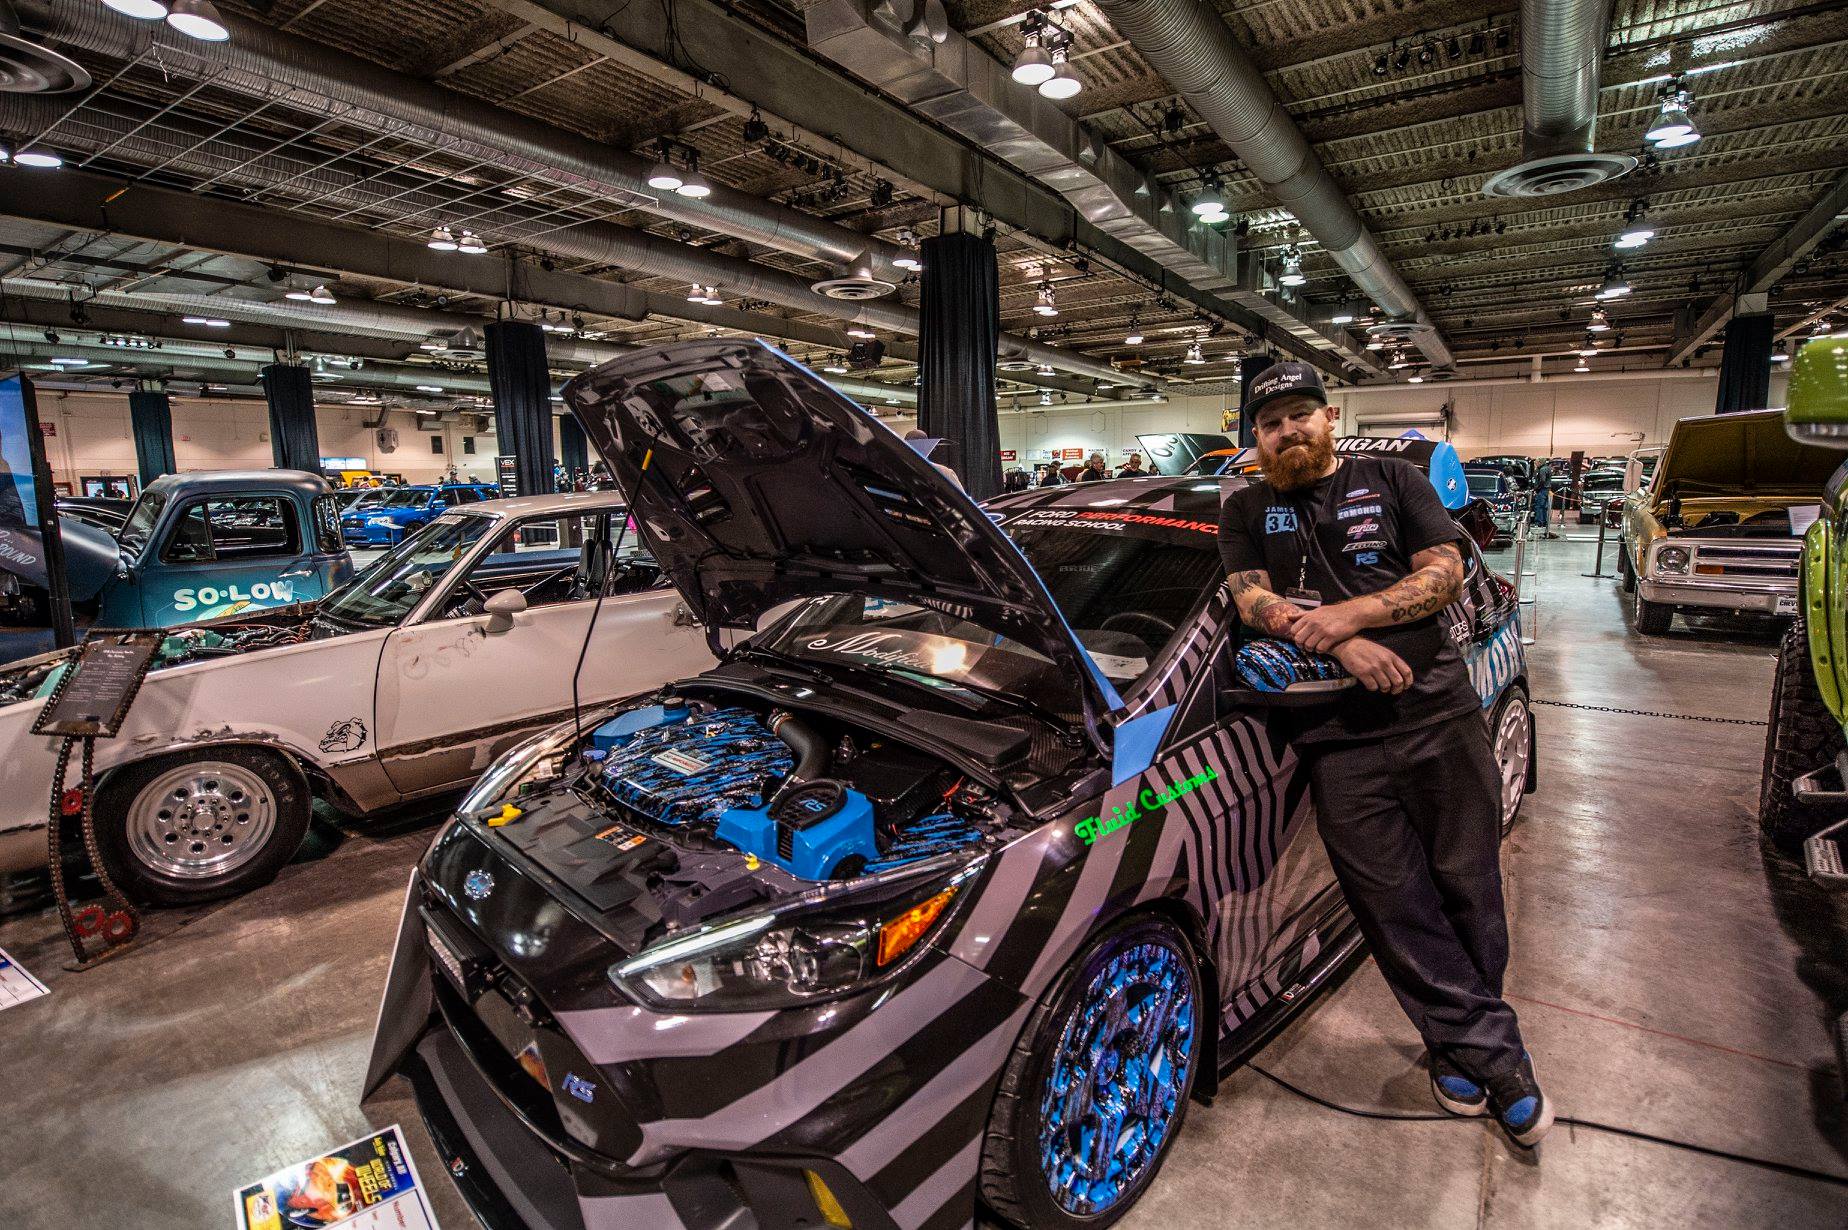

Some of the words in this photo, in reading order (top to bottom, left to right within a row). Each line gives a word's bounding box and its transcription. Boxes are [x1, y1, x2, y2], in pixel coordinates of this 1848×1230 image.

[1254, 377, 1279, 394] Drifting
[1280, 373, 1302, 382] Angel
[1265, 381, 1293, 395] Designs
[1029, 510, 1079, 519] FORD
[1012, 518, 1066, 527] RACING
[1065, 520, 1127, 531] SCHOOL
[1268, 514, 1297, 532] 34
[1355, 551, 1379, 566] RS
[800, 799, 828, 812] RS
[1074, 801, 1142, 846] Fluid
[1139, 765, 1218, 811] Customs
[562, 1071, 597, 1103] RS
[355, 1164, 383, 1204] WHEELS
